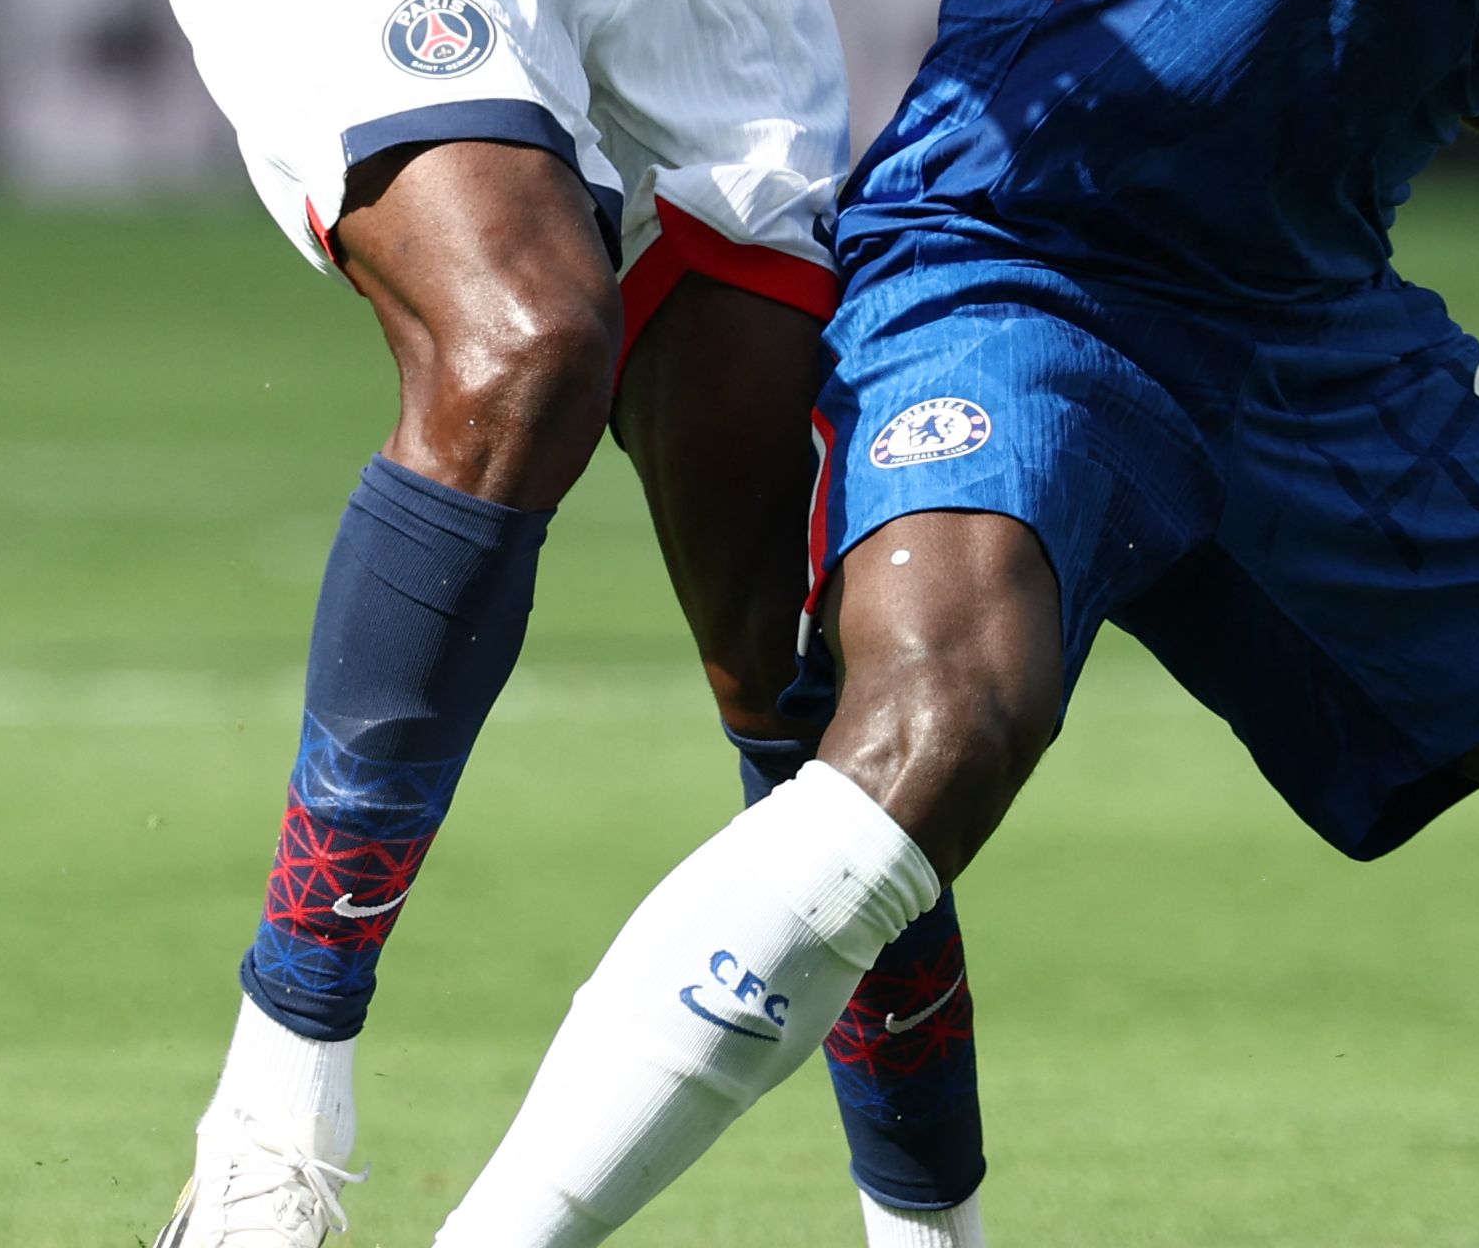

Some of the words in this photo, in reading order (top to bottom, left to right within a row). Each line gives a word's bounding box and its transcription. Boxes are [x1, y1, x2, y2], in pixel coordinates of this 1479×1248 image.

[411, 60, 439, 73] SAINT
[891, 400, 967, 431] CHELSEA
[710, 949, 789, 1027] CFC
